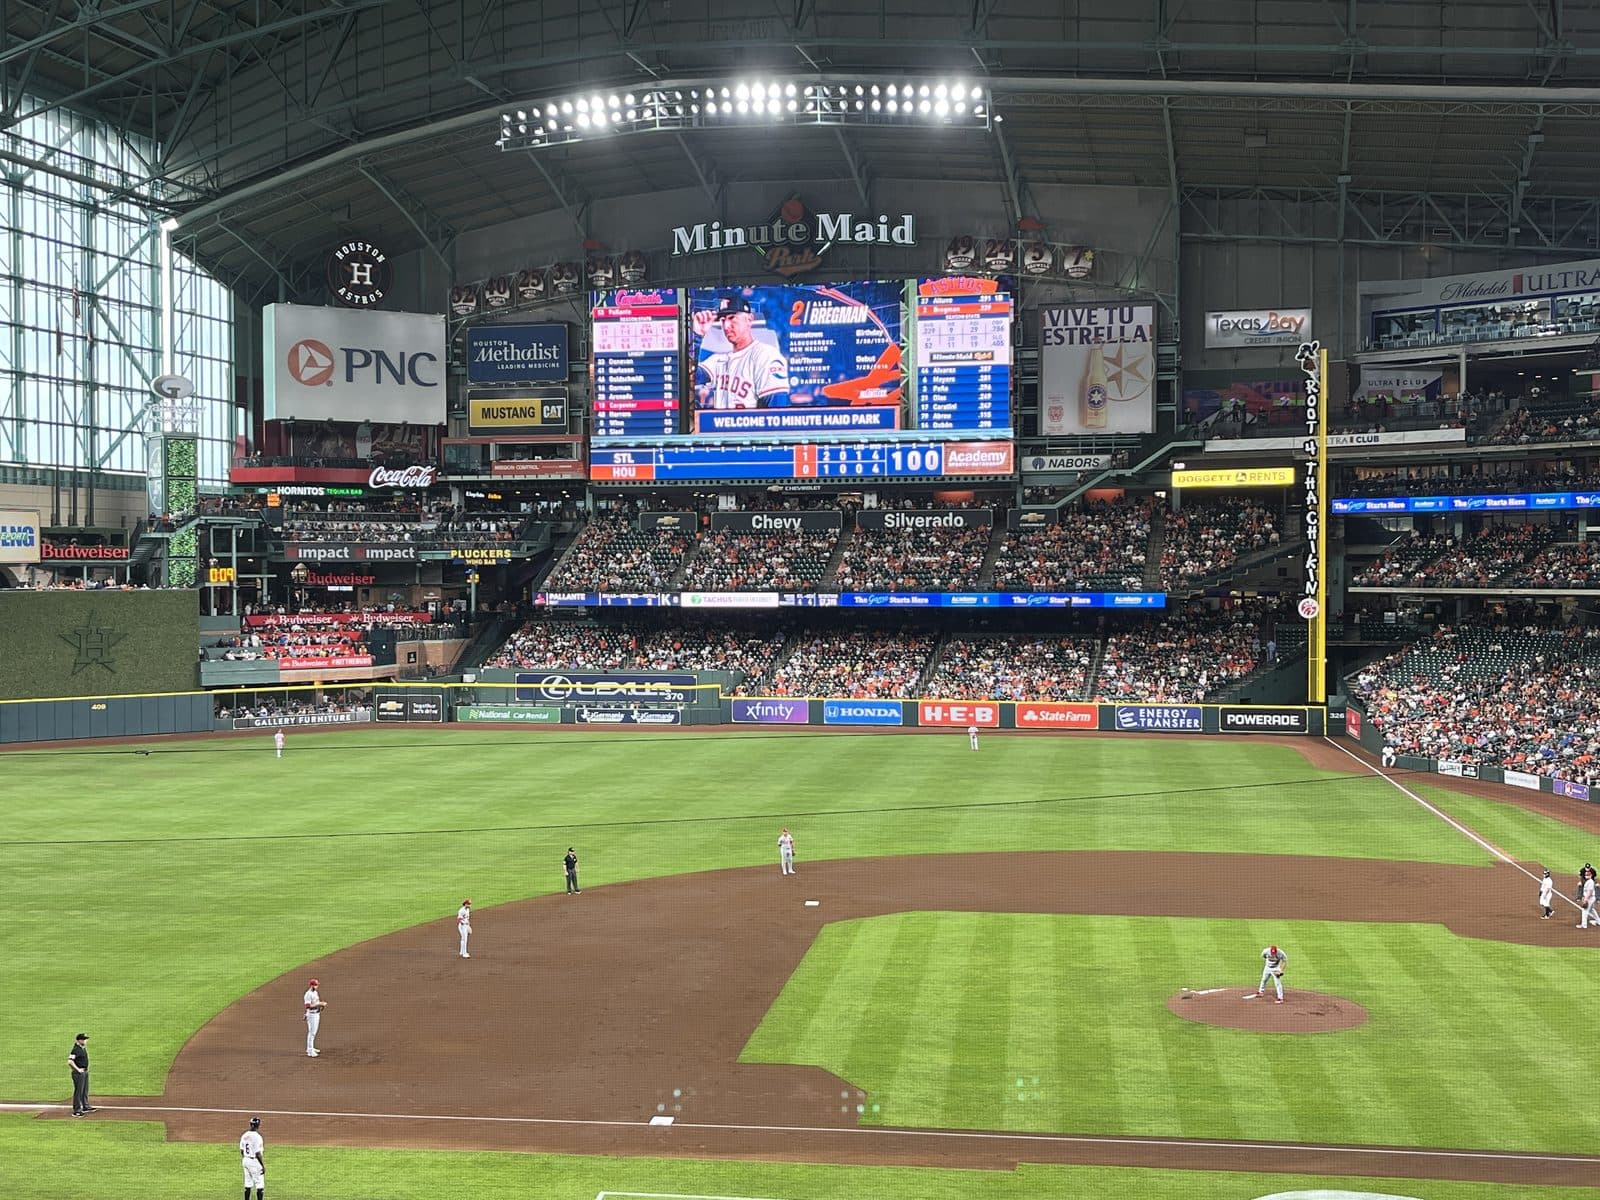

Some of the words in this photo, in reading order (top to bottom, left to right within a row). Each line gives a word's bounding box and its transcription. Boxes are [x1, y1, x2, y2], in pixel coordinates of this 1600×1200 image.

[672, 219, 808, 255] Minute
[816, 213, 915, 244] Maid
[335, 242, 386, 264] HOUSTON
[350, 263, 373, 285] H
[338, 289, 384, 305] ASTROS
[1440, 280, 1508, 300] Michelob
[789, 300, 805, 325] 2
[809, 305, 868, 324] BREGMAN
[1105, 306, 1134, 325] TU
[1212, 314, 1261, 337] Texas
[1269, 312, 1305, 333] Bay
[474, 343, 560, 362] Methodist
[340, 347, 438, 387] PNC
[1368, 379, 1393, 387] ULTRA
[481, 407, 536, 419] MUSTANG
[543, 405, 564, 419] CAT
[1305, 380, 1319, 434] ROOT
[714, 416, 765, 428] WELCOME
[767, 415, 779, 426] TO
[782, 414, 820, 426] MINUTE
[823, 414, 850, 425] MAID
[852, 413, 880, 424] PARK
[1356, 435, 1379, 443] CLUB
[1304, 440, 1316, 455] 4
[613, 453, 635, 464] STL
[659, 454, 664, 464] 1
[803, 452, 807, 460] 1
[823, 451, 830, 461] 2
[839, 451, 847, 460] 0
[856, 451, 861, 460] 1
[871, 451, 879, 460] 4
[892, 450, 902, 470] 1
[907, 450, 921, 471] 0
[925, 450, 939, 471] 0
[949, 450, 1007, 465] Academy
[1048, 458, 1100, 468] NABORS
[612, 466, 636, 478] HOU
[803, 464, 809, 474] 0
[824, 464, 829, 474] 1
[839, 464, 847, 474] 0
[856, 464, 863, 474] 0
[872, 464, 880, 474] 4
[1178, 474, 1232, 483] DOGGETT
[1249, 472, 1286, 481] RENTS
[277, 486, 325, 495] HORNITOS
[1304, 462, 1318, 505] THA
[1453, 499, 1467, 507] The
[1576, 496, 1589, 504] The
[752, 514, 801, 530] Chevy
[884, 512, 964, 528] Silverado
[41, 545, 129, 559] Budweiser
[451, 549, 511, 558] PLUCKERS
[1305, 511, 1318, 595] CHIKIN
[209, 568, 234, 582] 0:09
[307, 572, 376, 585] Budweiser
[662, 594, 671, 605] K
[1012, 596, 1027, 604] The
[1071, 596, 1091, 604] Here
[279, 615, 332, 625] Budweiser
[363, 613, 413, 623] Budweiser
[664, 692, 684, 700] 370
[479, 710, 511, 719] National
[526, 711, 549, 720] Rental
[746, 704, 794, 720] xfinity
[840, 708, 899, 717] HONDA
[1140, 708, 1188, 718] ENERGY
[255, 715, 296, 727] GALLERY
[298, 713, 351, 724] FURNITURE
[1138, 718, 1200, 728] TRANSFER
[1227, 714, 1300, 725] POWERADE
